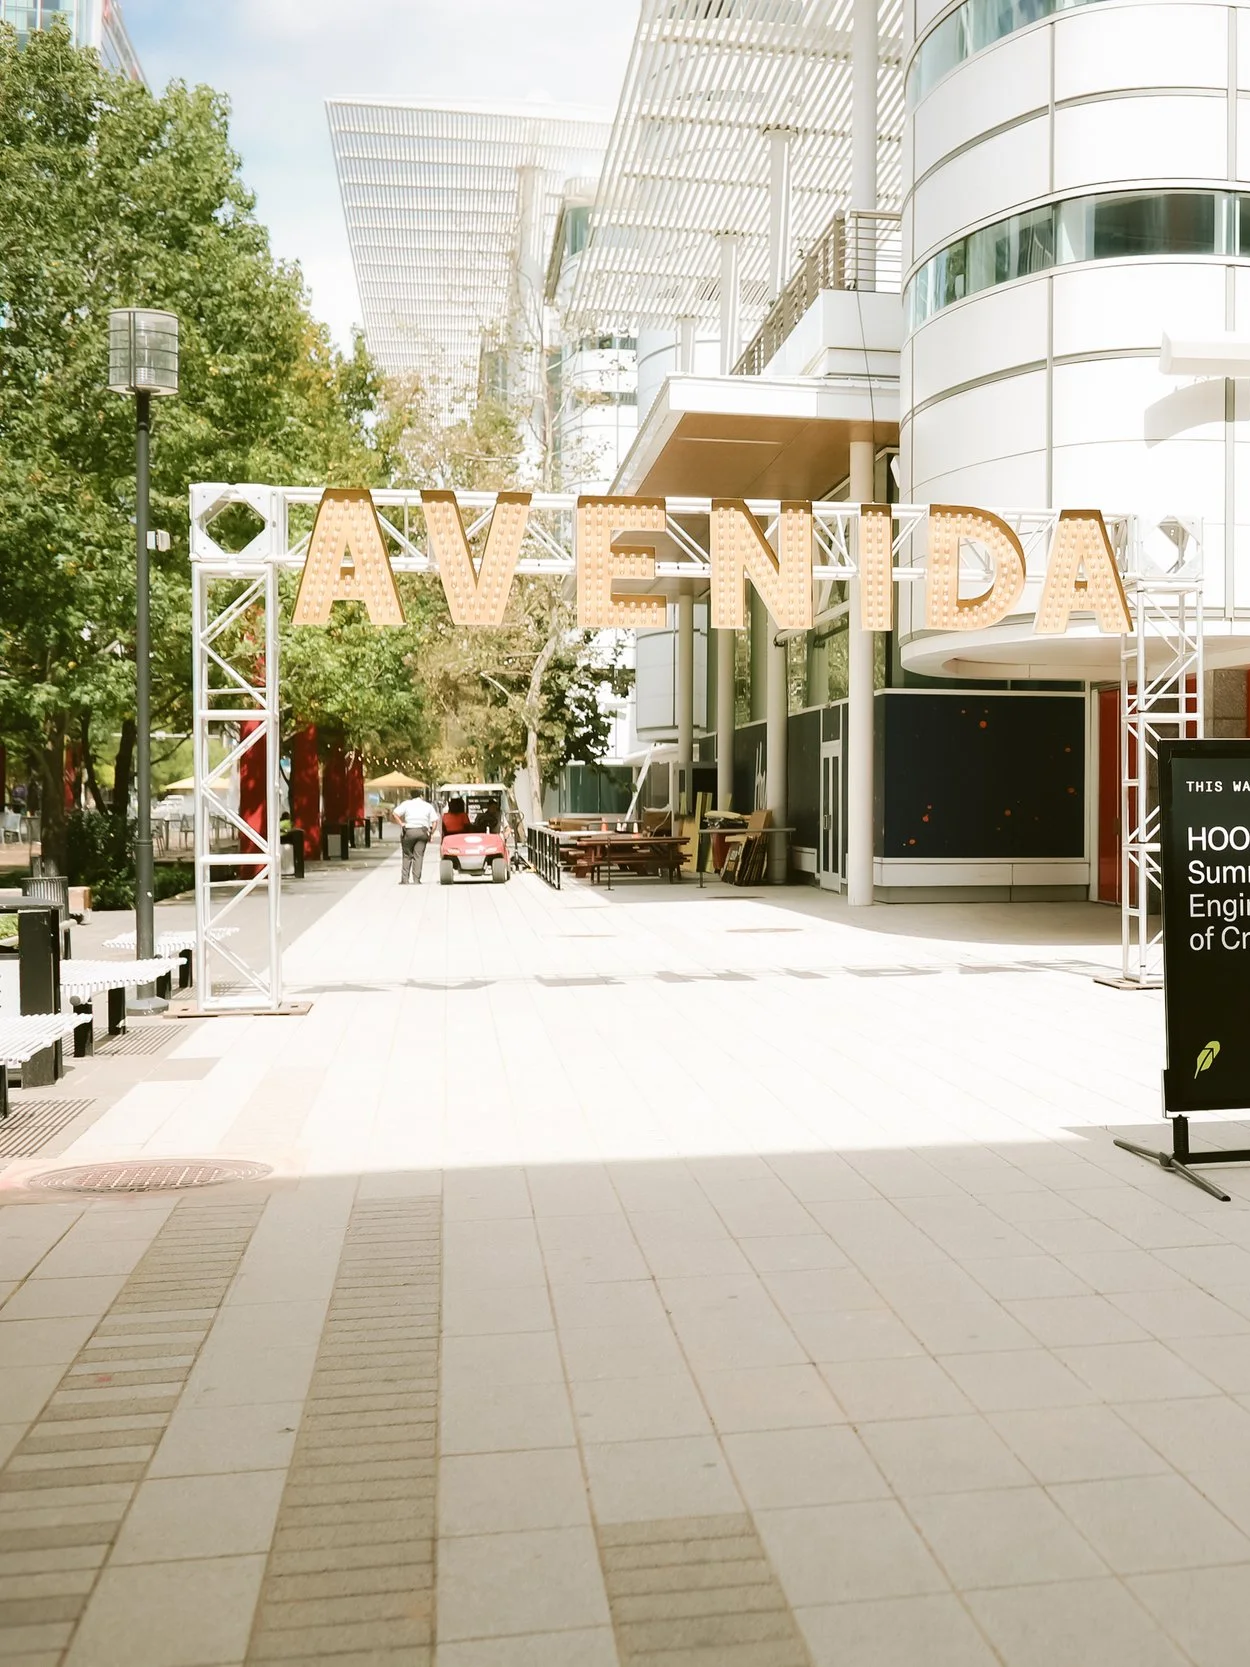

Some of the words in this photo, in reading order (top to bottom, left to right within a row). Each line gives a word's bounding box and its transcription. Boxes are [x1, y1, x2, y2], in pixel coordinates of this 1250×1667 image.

[291, 487, 1134, 635] AVENIDA
[1185, 780, 1223, 793] THIS
[1189, 925, 1215, 951] of
